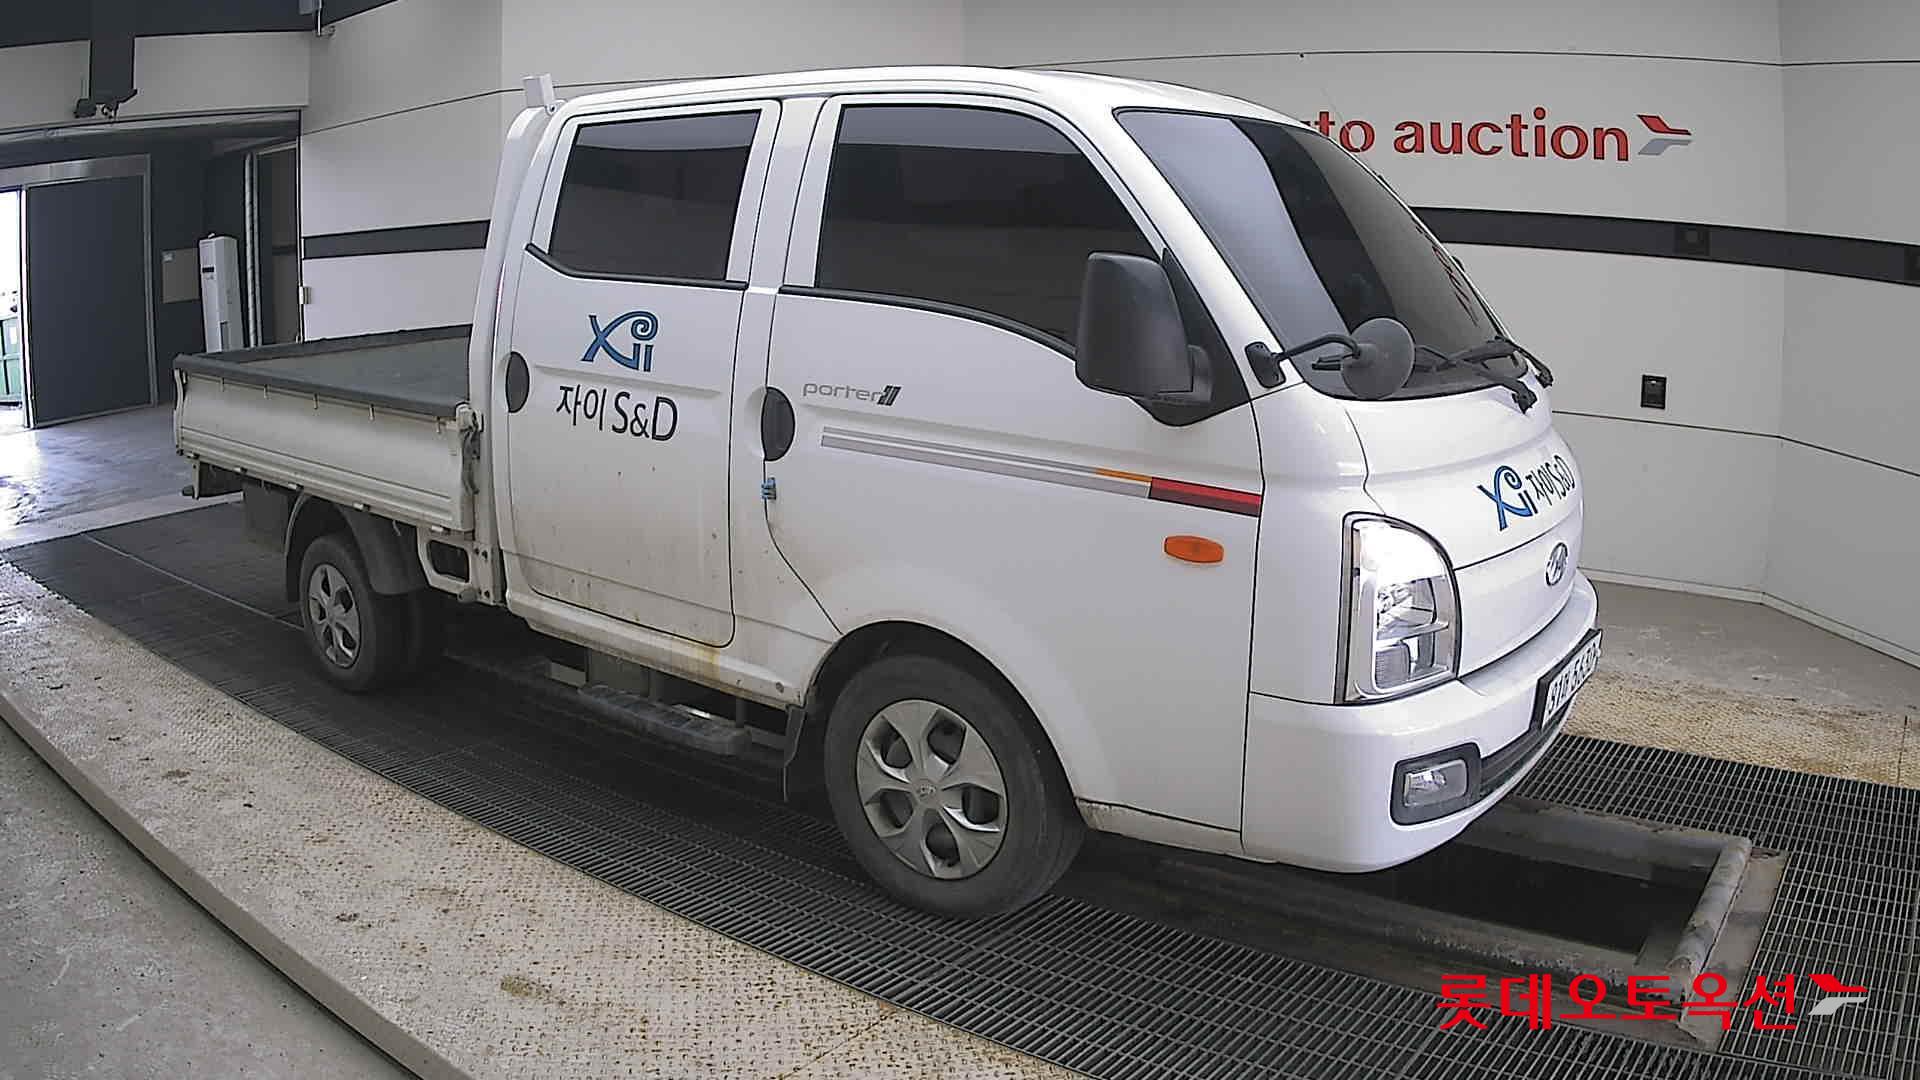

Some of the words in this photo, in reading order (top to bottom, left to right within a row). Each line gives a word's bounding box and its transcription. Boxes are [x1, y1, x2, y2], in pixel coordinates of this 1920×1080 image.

[1301, 111, 1375, 153] to
[1393, 106, 1630, 162] auction
[802, 382, 881, 402] porter
